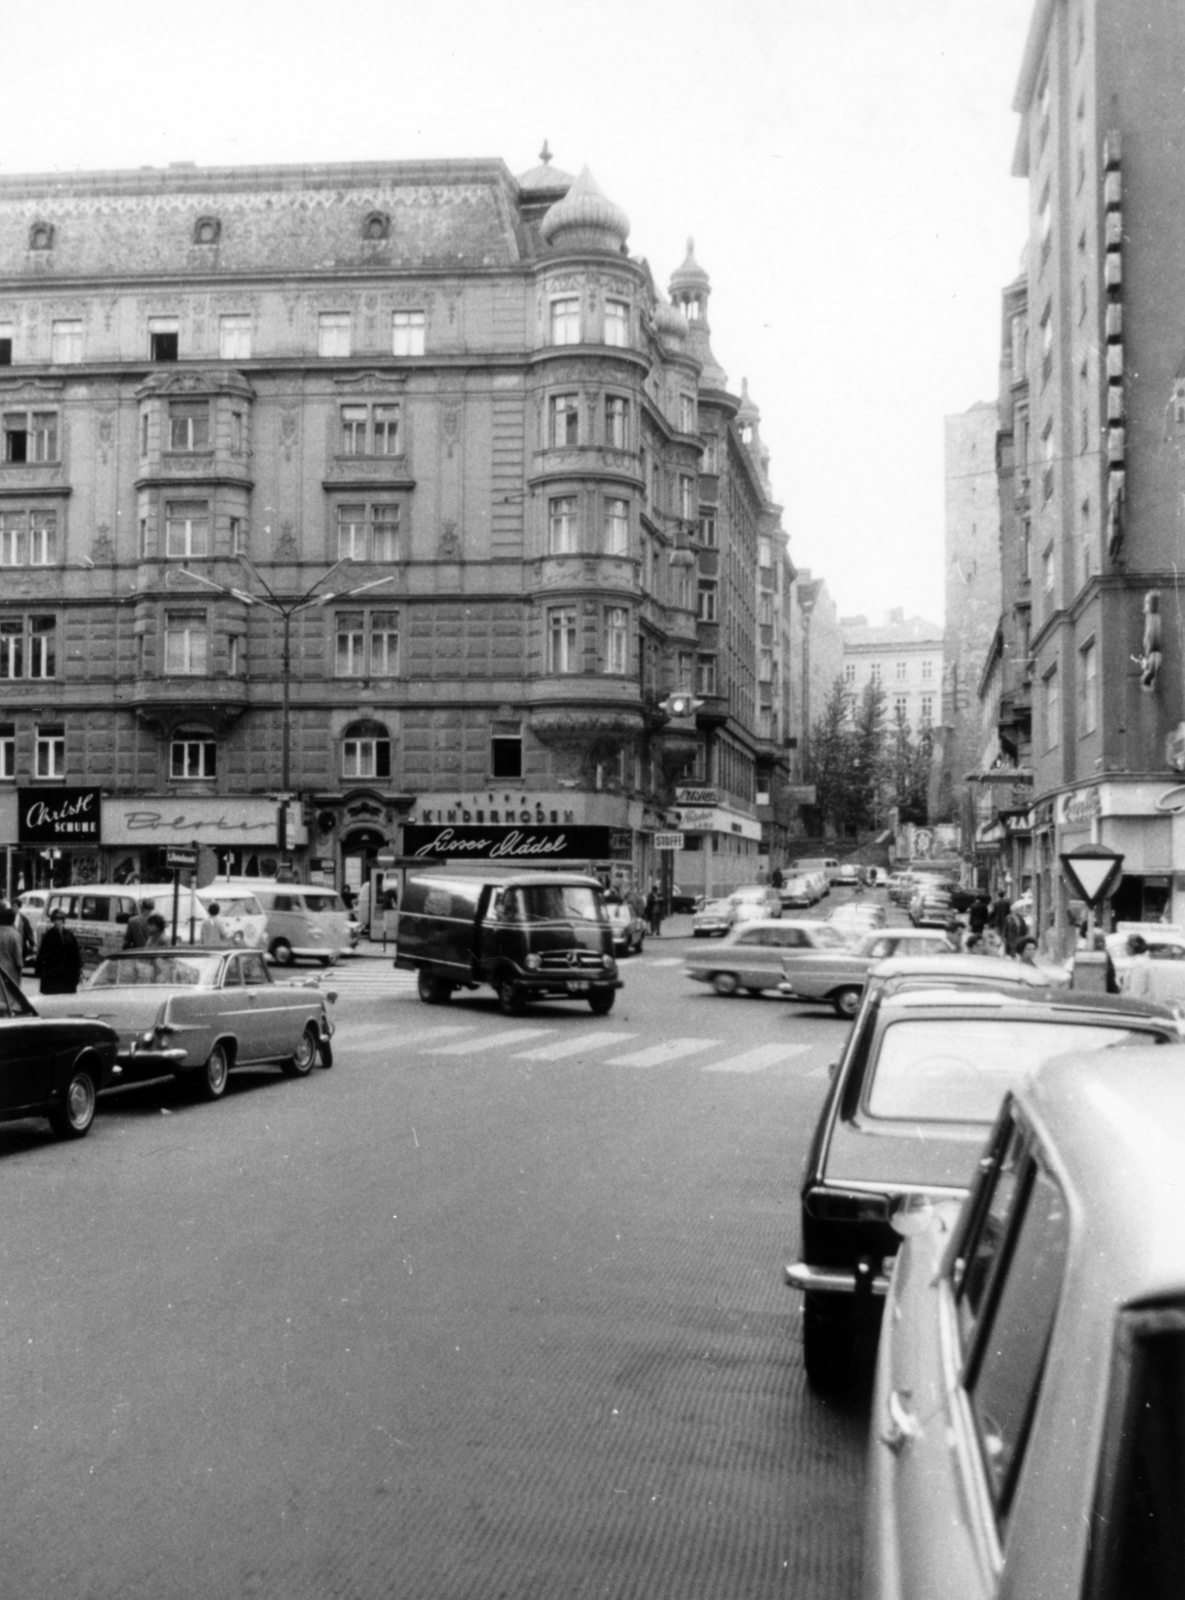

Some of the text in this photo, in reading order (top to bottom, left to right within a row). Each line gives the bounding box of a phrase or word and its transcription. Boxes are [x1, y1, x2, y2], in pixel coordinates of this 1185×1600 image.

[26, 793, 94, 828] Christl
[422, 809, 574, 824] KINDERMODEN
[54, 821, 97, 832] SCHUHE
[489, 830, 568, 858] Mädel
[655, 835, 682, 847] STOFFE
